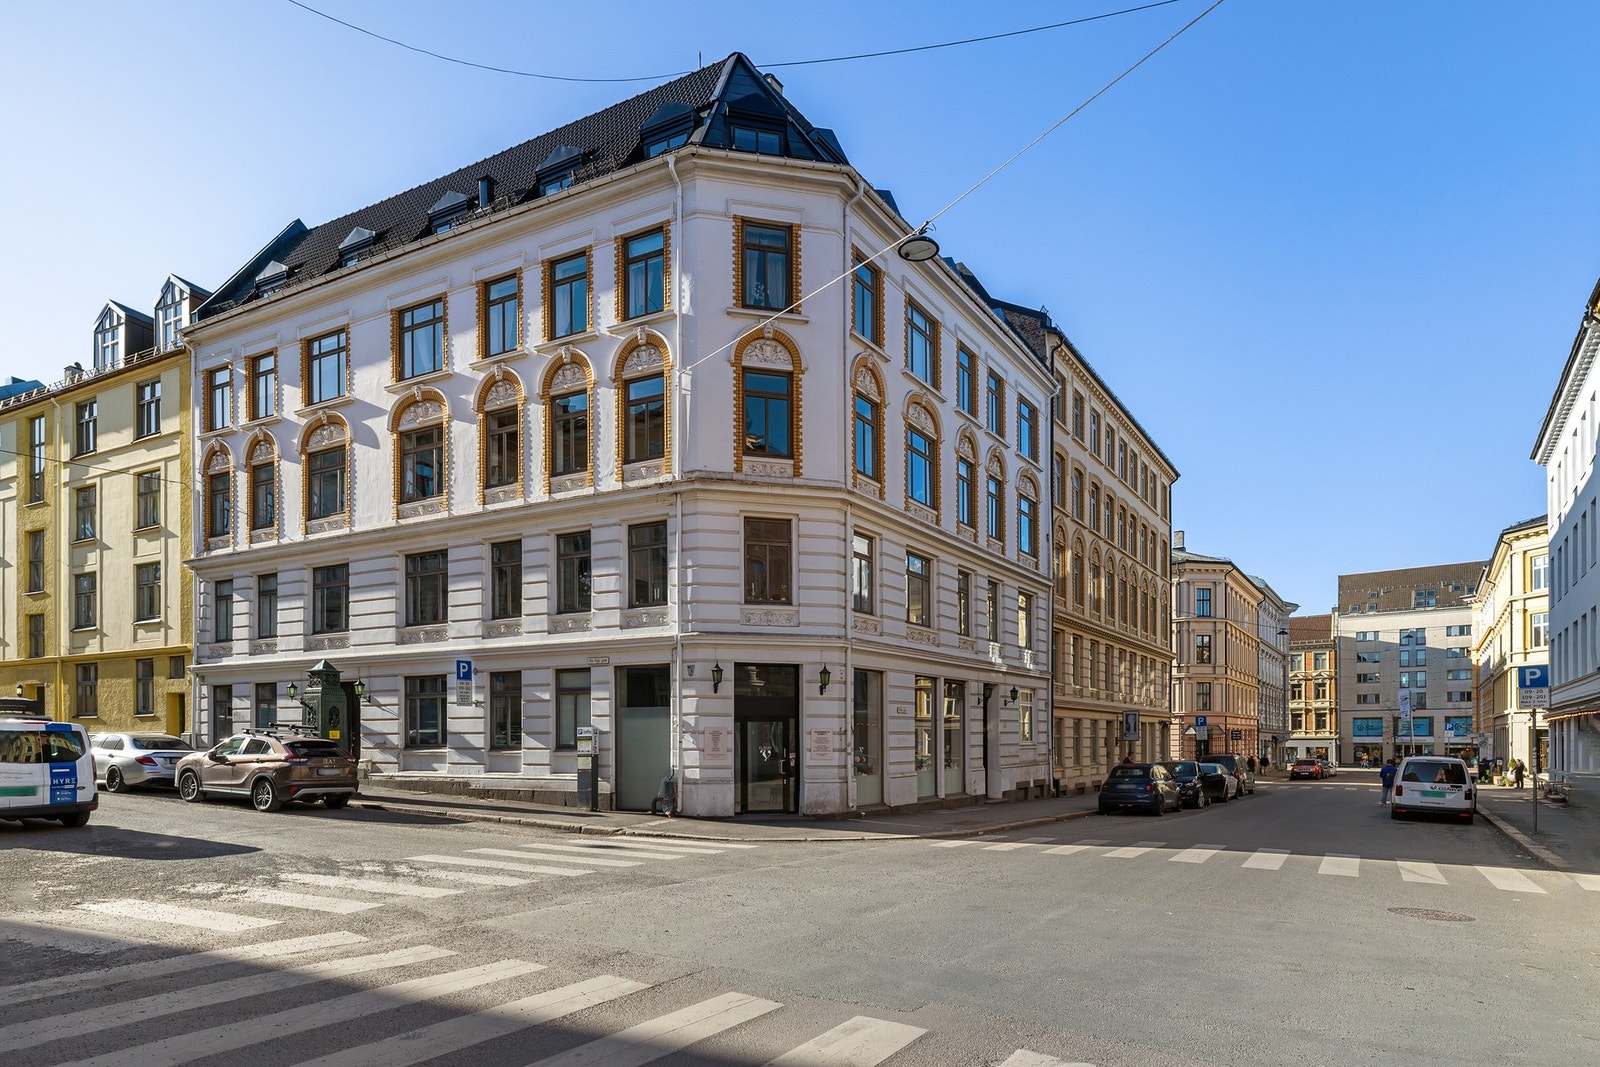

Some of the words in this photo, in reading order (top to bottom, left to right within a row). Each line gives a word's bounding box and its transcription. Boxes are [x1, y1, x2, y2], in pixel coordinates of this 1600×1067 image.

[460, 663, 468, 678] P
[1525, 668, 1541, 686] P
[1198, 717, 1204, 725] P
